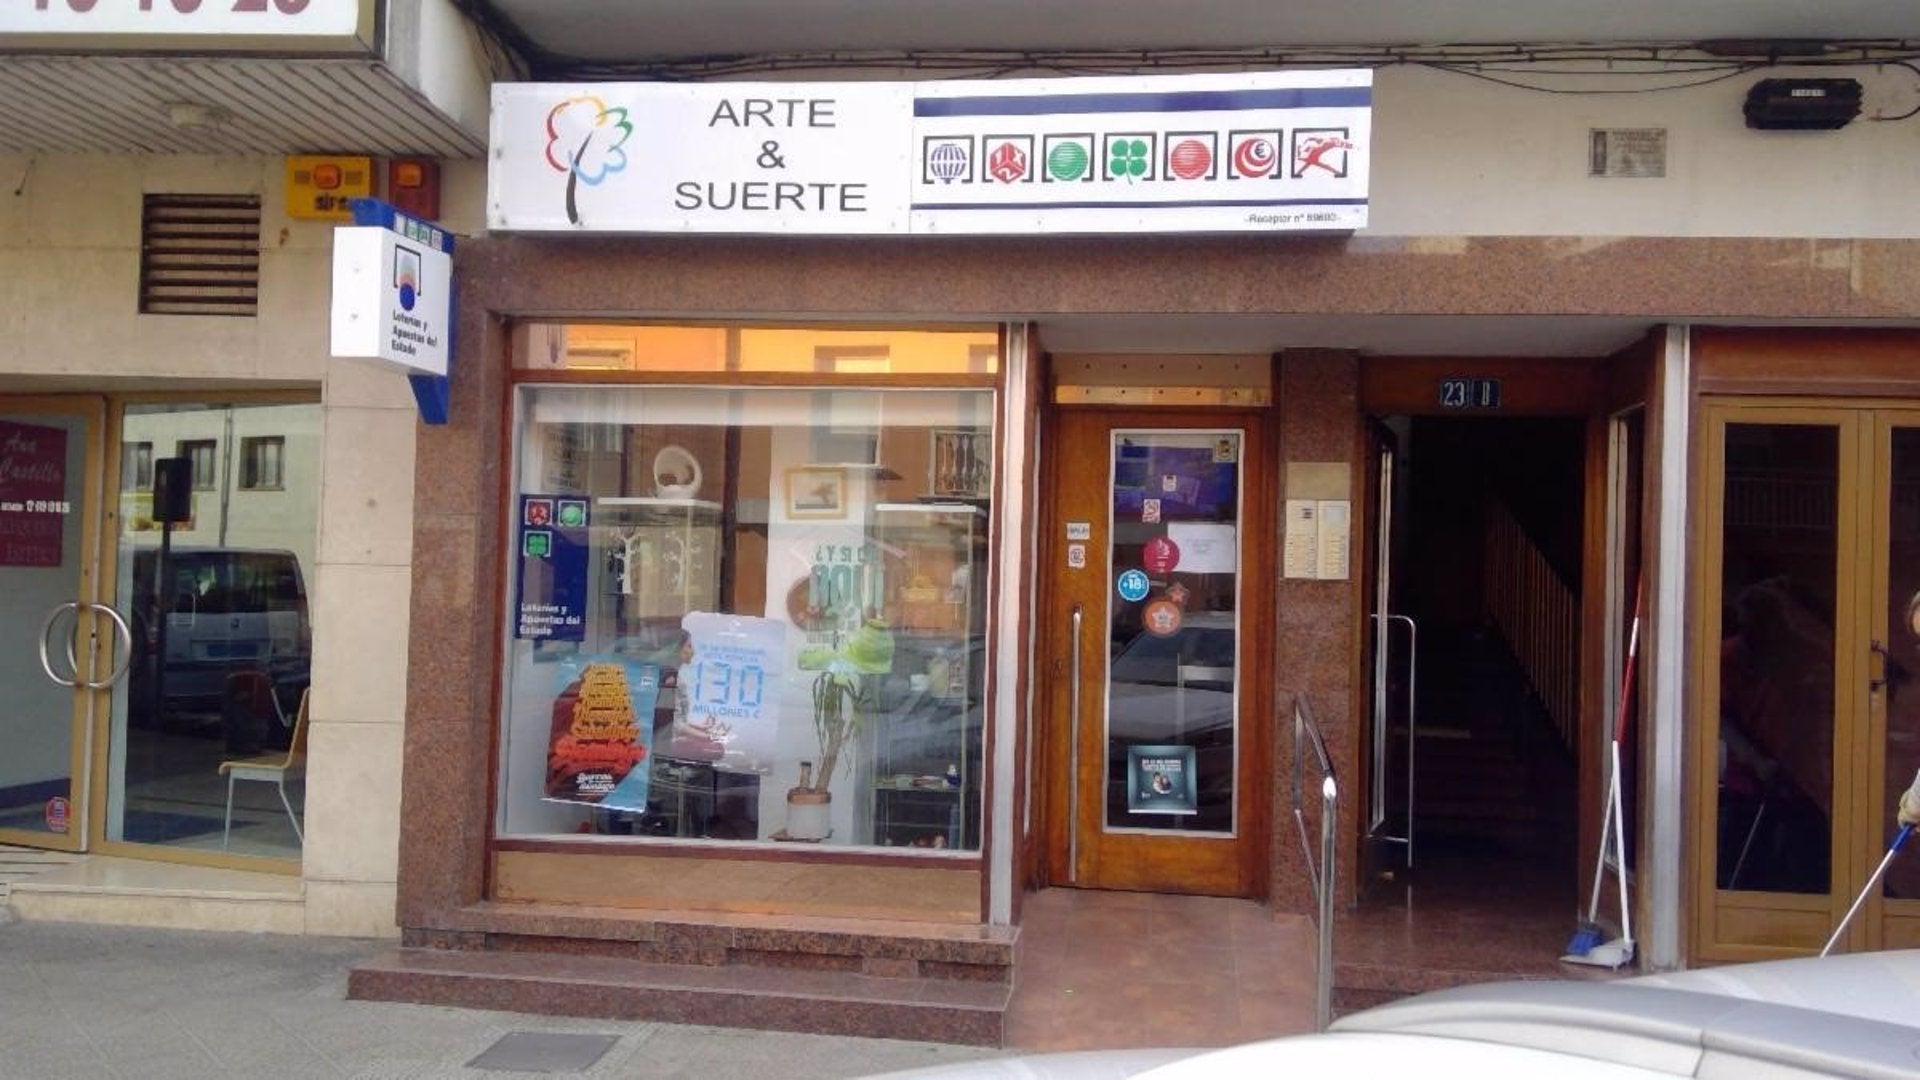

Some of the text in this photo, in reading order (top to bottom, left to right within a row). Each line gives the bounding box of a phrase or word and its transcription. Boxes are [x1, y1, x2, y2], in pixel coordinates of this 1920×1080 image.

[708, 98, 836, 128] ARTE
[756, 140, 786, 168] &
[674, 181, 868, 212] SUERTE
[392, 338, 416, 356] Estado
[1443, 381, 1465, 407] 23
[519, 624, 553, 635] Estado
[694, 660, 765, 707] 130
